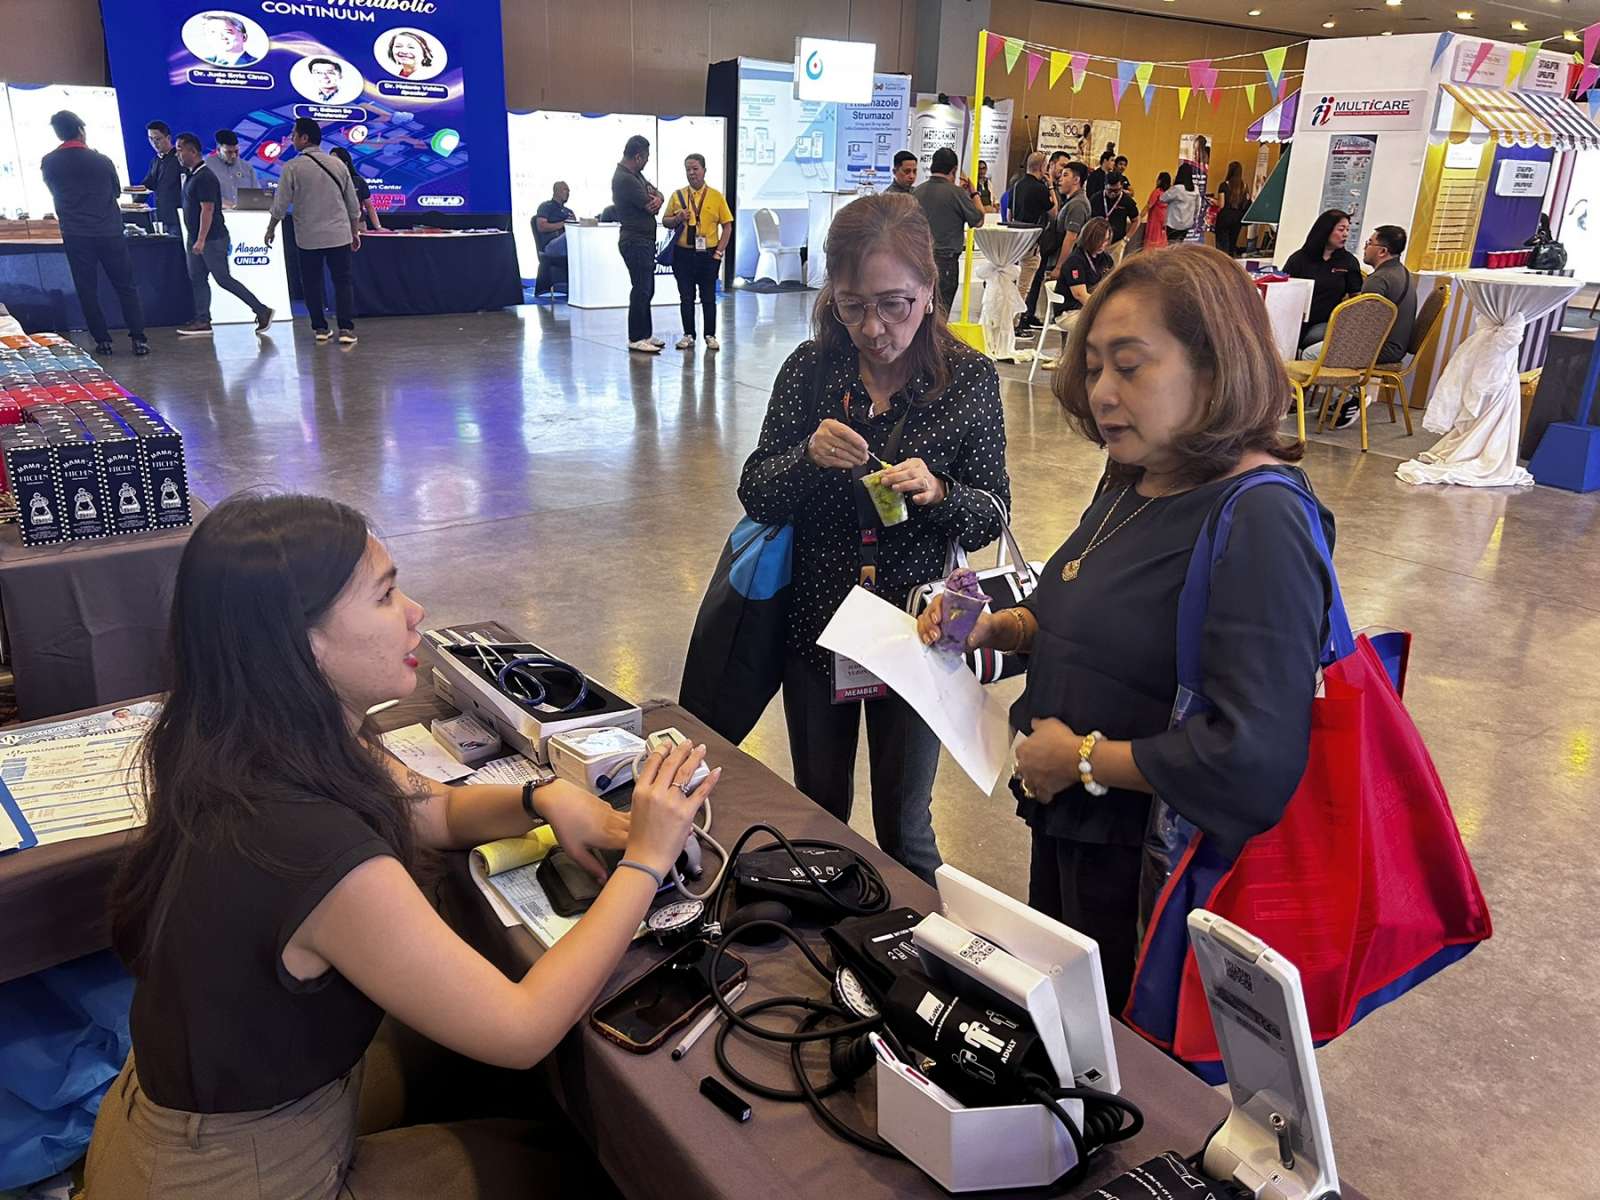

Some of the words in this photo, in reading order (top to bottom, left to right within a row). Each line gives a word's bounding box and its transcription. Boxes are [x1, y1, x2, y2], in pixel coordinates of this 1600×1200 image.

[261, 1, 375, 22] CONTINUUM
[852, 111, 894, 120] Strumazol
[421, 196, 461, 205] UNILAB
[235, 242, 269, 255] Alagang
[236, 257, 268, 265] UNILAB
[844, 686, 878, 697] MEMBER
[928, 1003, 942, 1024] KaWe
[1000, 1039, 1017, 1064] ADULT
